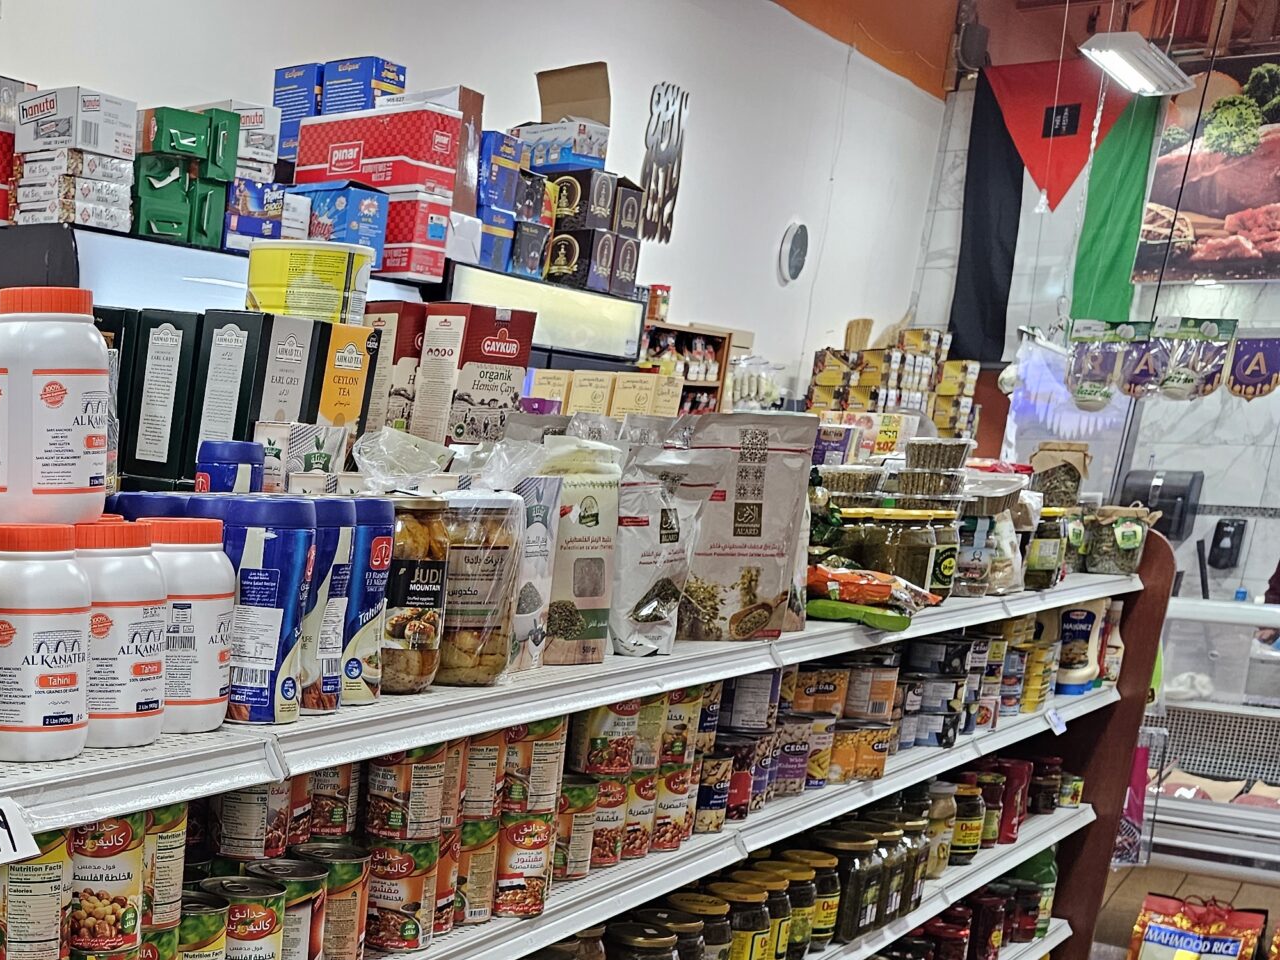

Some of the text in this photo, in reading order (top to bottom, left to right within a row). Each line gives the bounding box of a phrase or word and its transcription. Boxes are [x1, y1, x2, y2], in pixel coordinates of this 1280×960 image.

[21, 95, 56, 119] hanuta
[240, 113, 265, 127] anuta
[1244, 351, 1266, 375] A
[271, 376, 299, 385] EARL GREY
[333, 375, 359, 386] CEYLON
[480, 368, 513, 382] organik
[338, 388, 350, 396] TEA
[410, 567, 443, 585] JUDI
[22, 651, 86, 669] AL KANATER
[140, 663, 158, 674] Tahini
[47, 675, 71, 686] Tahini
[1147, 929, 1236, 955] MAHMOOD RICE
